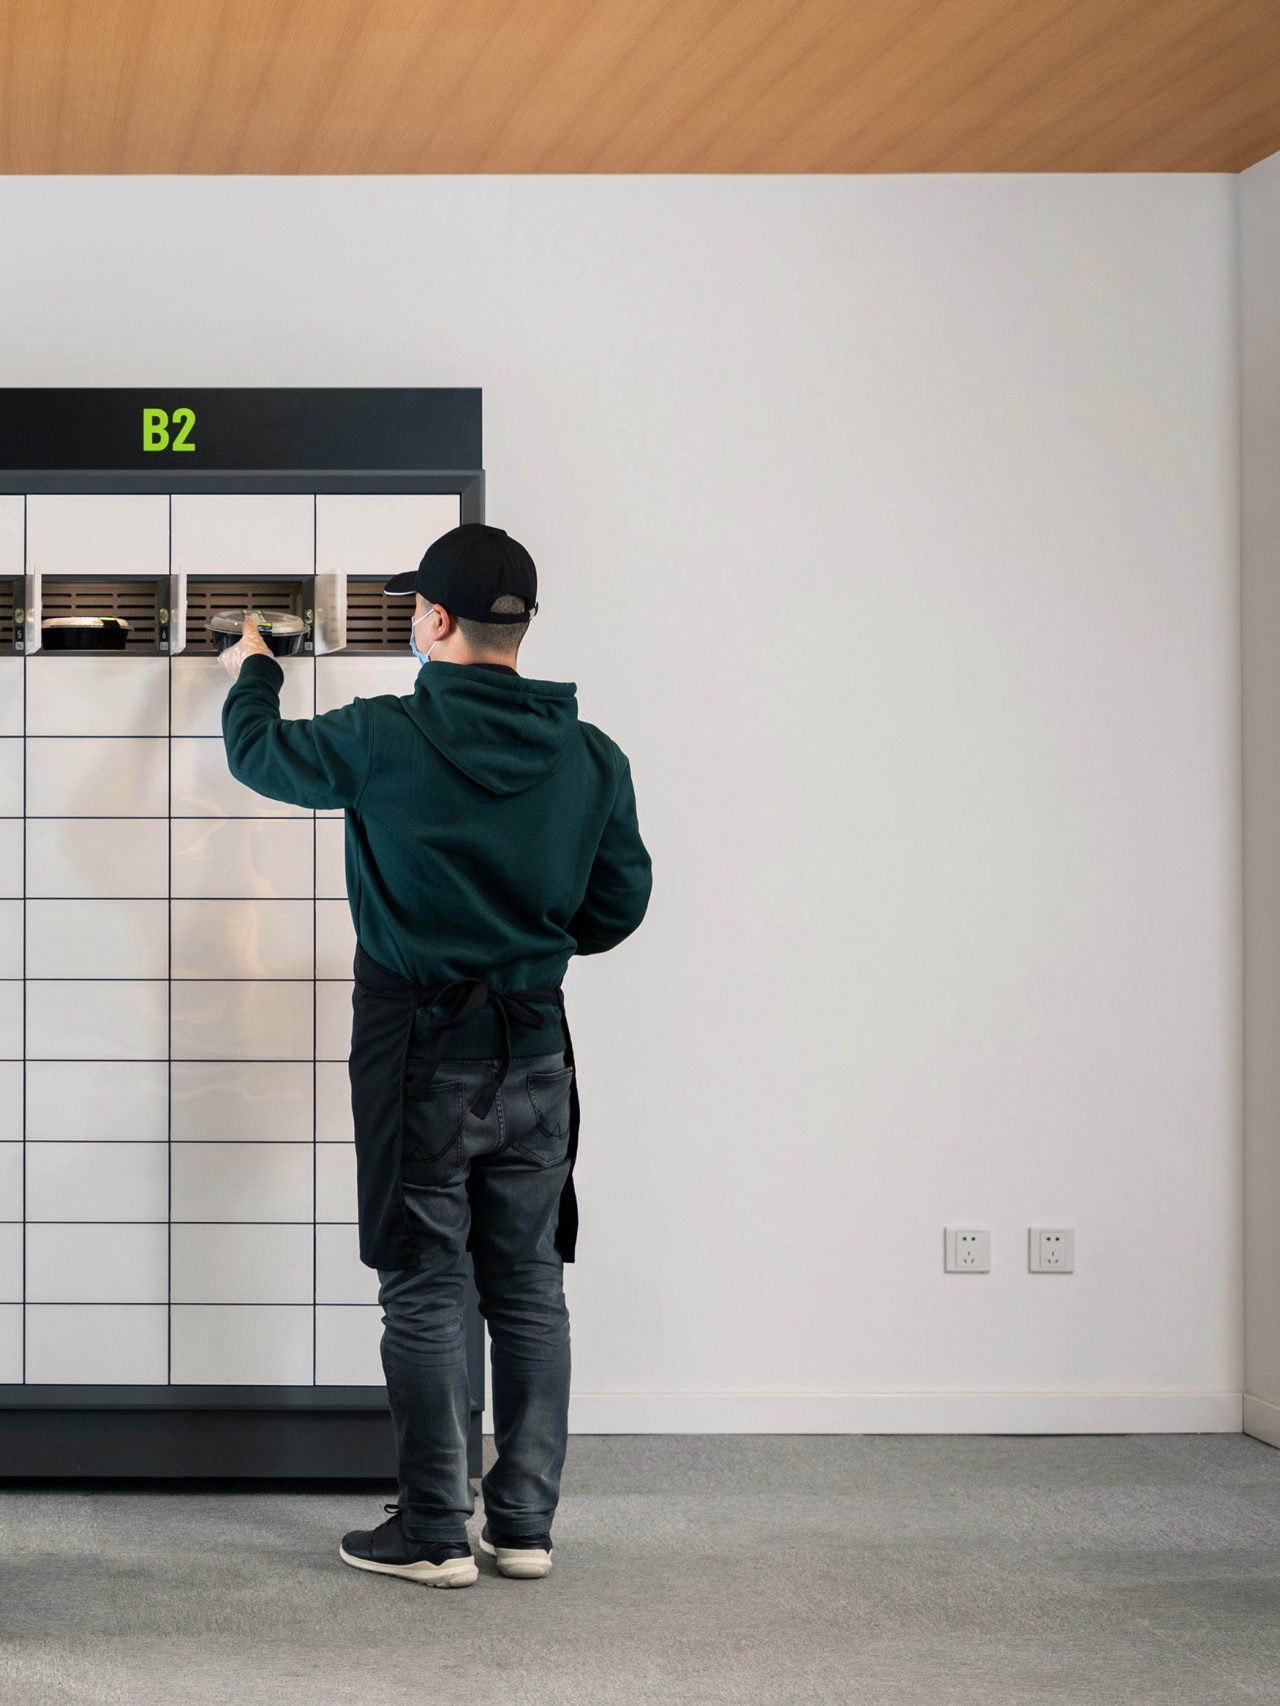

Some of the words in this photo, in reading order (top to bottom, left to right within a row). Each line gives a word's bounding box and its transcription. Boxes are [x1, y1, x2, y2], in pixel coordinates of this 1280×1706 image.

[143, 407, 196, 452] B2
[17, 630, 22, 639] 5
[162, 630, 167, 639] 6
